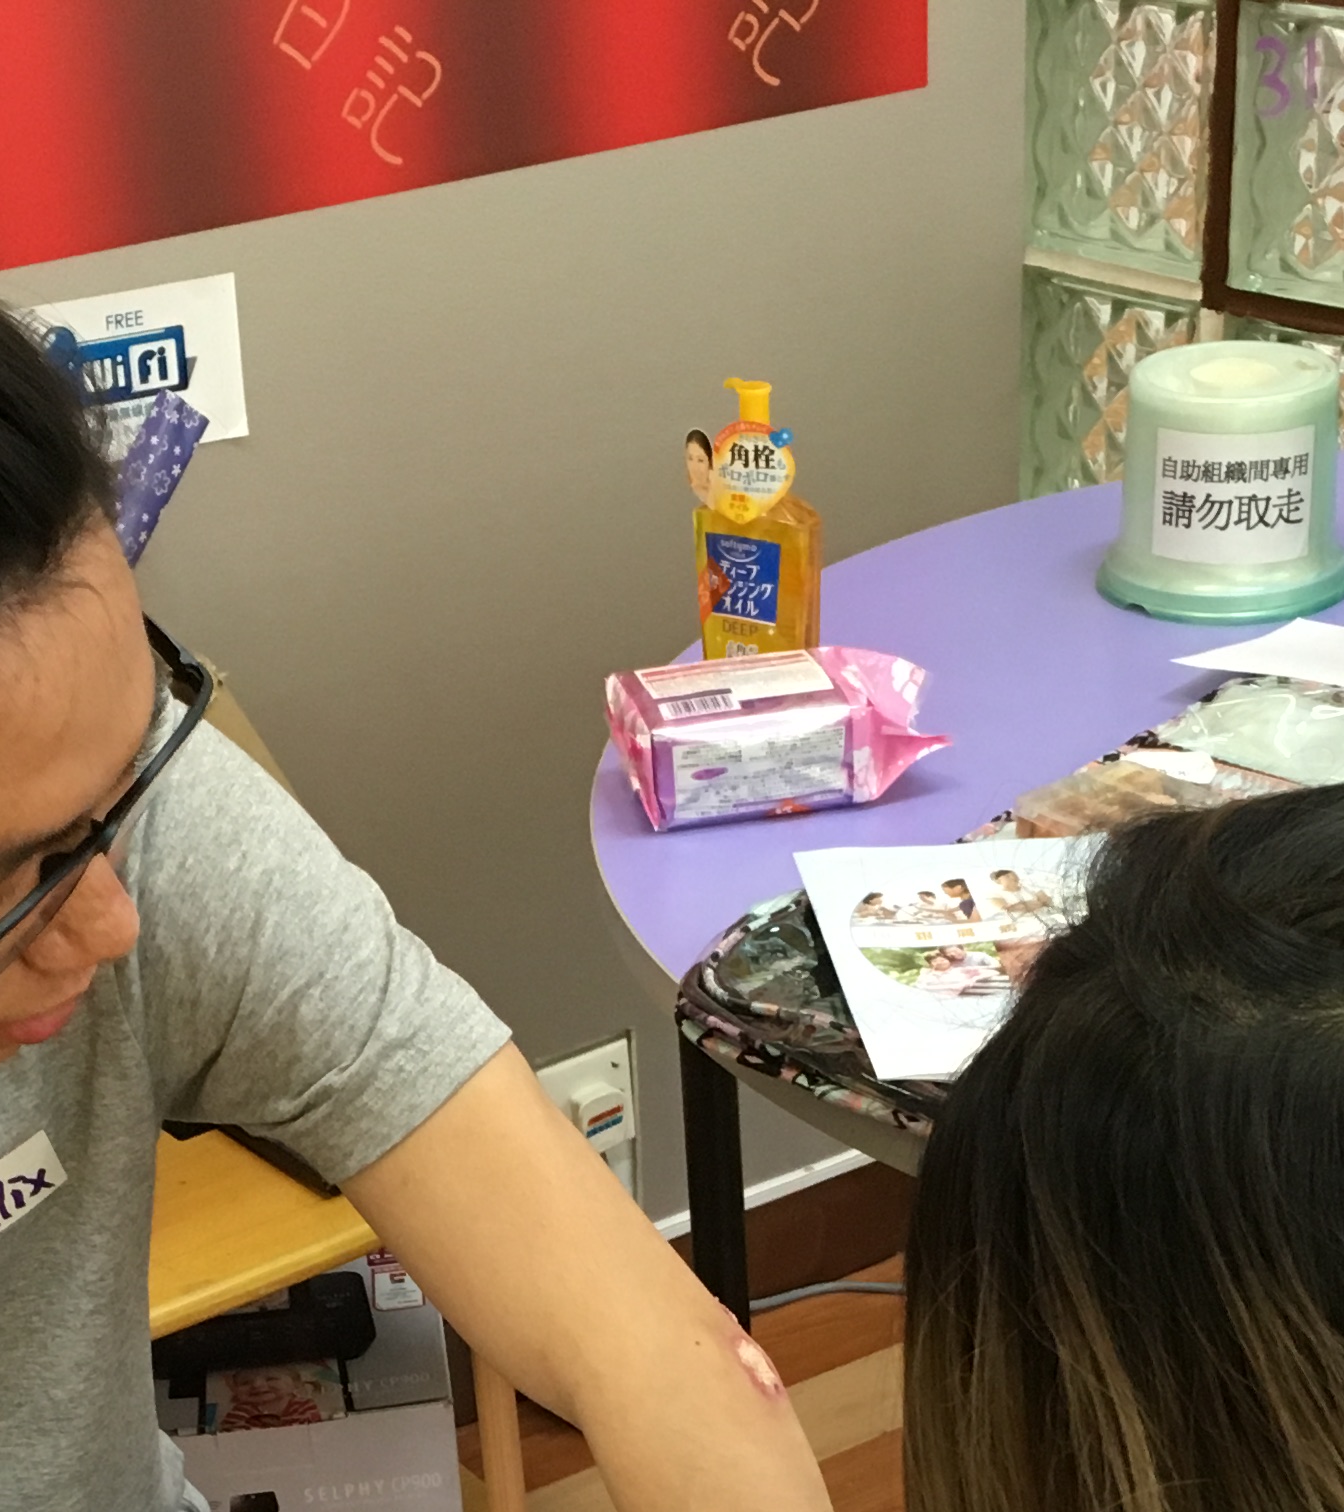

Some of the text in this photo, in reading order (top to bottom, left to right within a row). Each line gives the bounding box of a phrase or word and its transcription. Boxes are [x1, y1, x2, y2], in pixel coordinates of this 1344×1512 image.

[105, 309, 144, 331] FREE
[1161, 453, 1309, 484] 自助組織間專用
[1162, 488, 1305, 531] 請勿取走
[721, 596, 760, 617] オイル
[722, 619, 759, 638] DEEP
[303, 1479, 385, 1504] SELPHY
[391, 1472, 442, 1493] CP900
